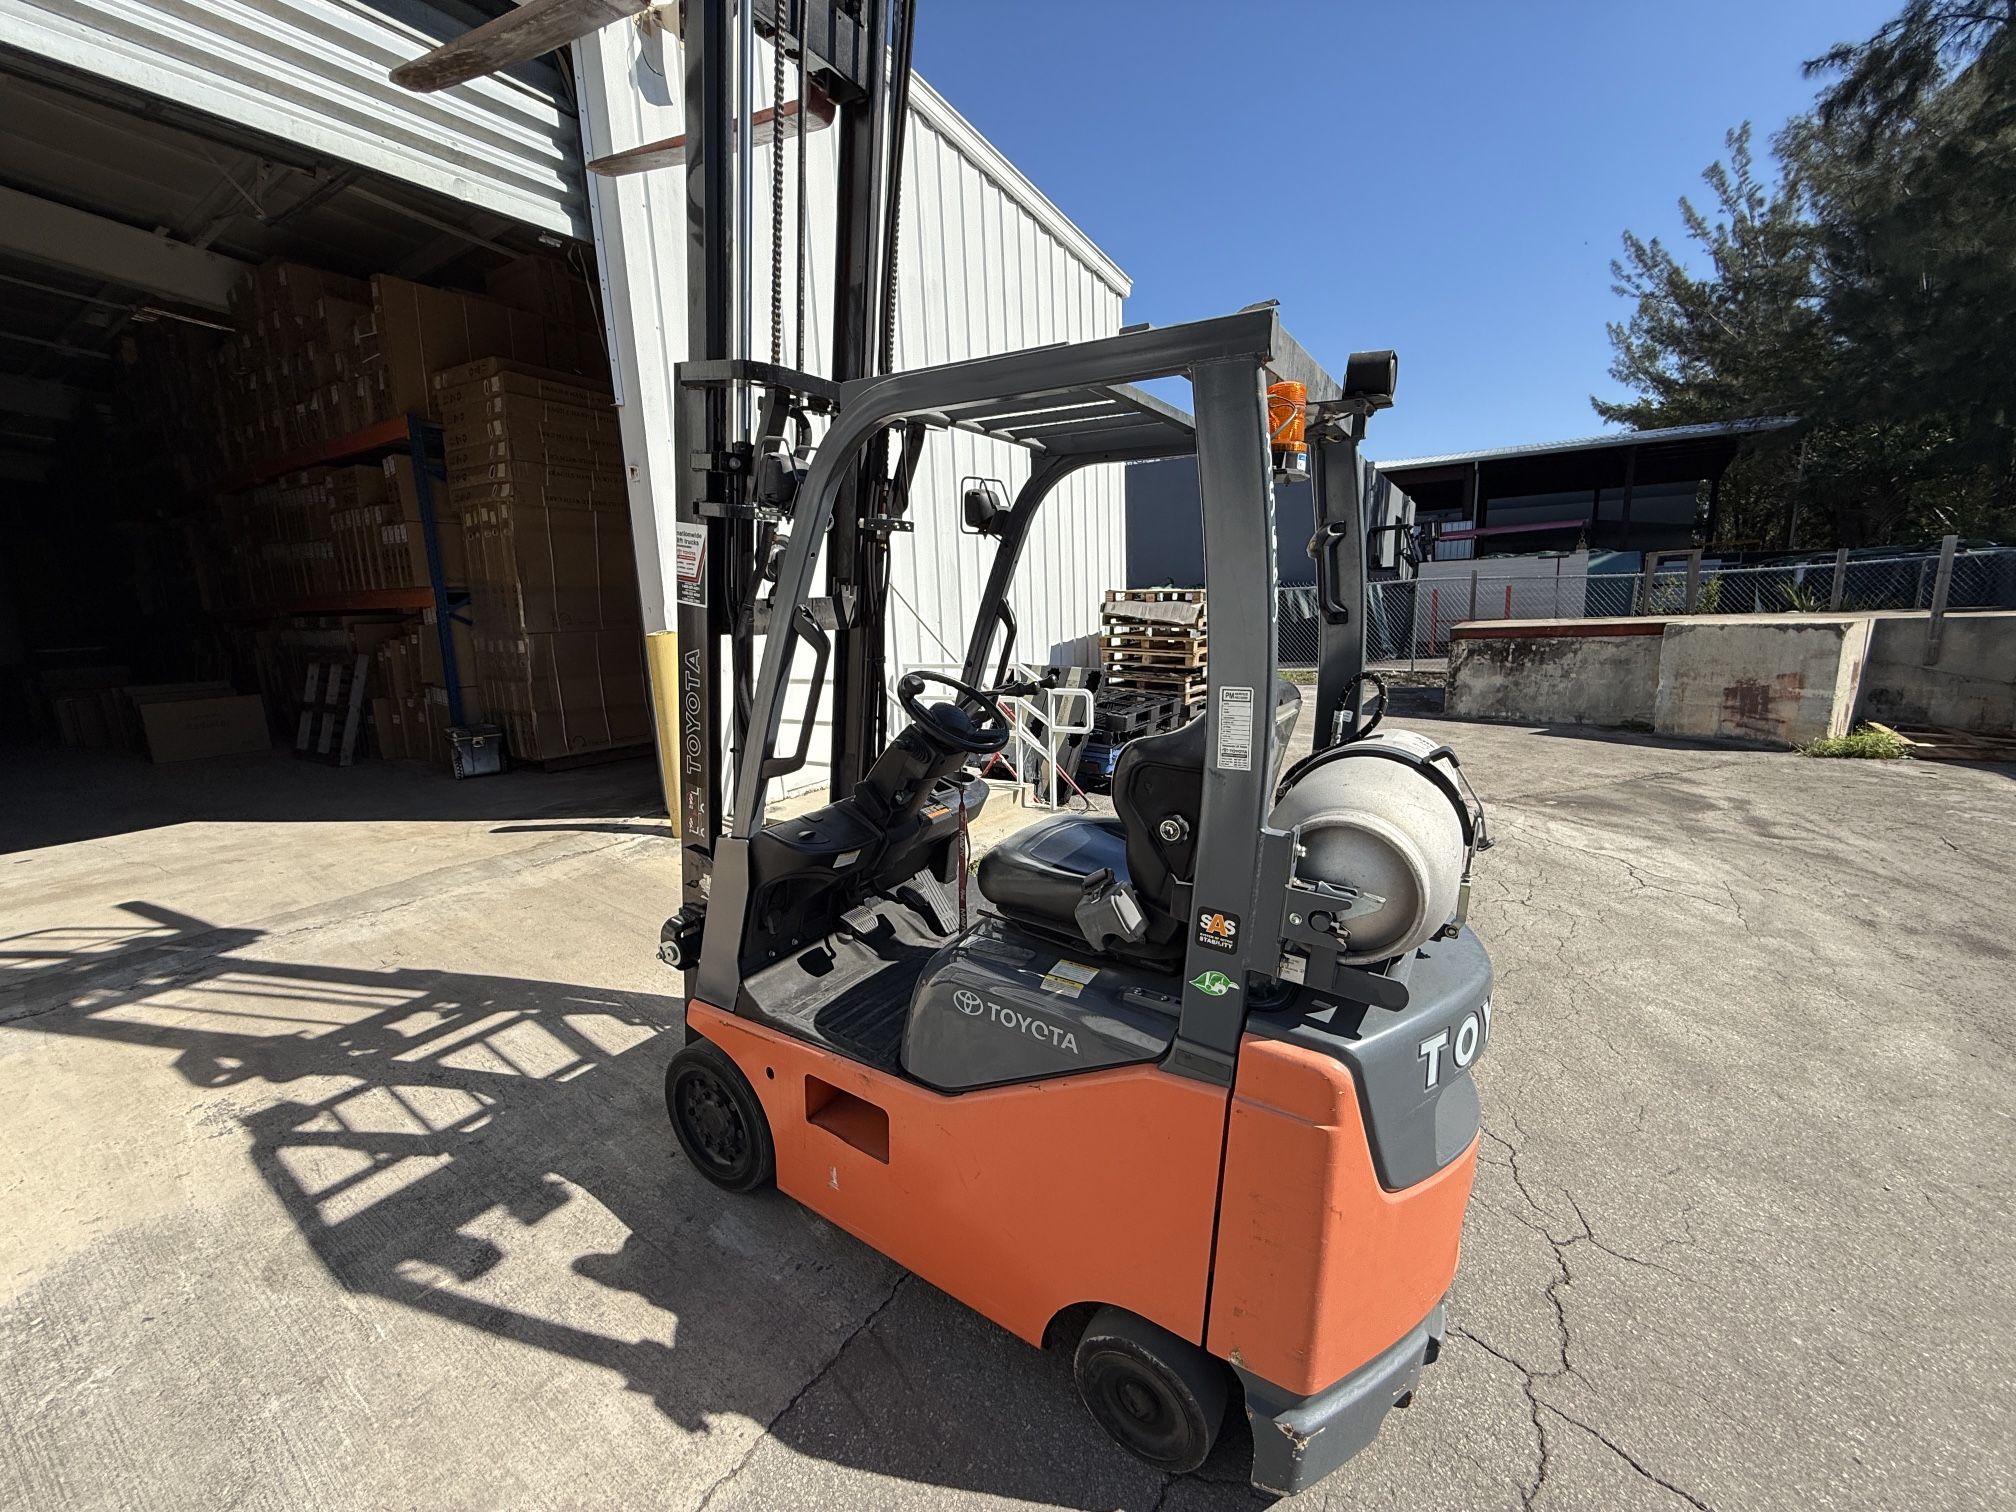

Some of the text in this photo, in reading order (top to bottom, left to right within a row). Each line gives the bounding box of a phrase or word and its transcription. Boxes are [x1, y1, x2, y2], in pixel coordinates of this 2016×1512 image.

[1225, 691, 1235, 700] PM
[684, 648, 702, 775] TOYOTA
[1199, 913, 1236, 937] SAS
[1199, 935, 1233, 950] STABILITY
[987, 1001, 1079, 1055] TOYOTA
